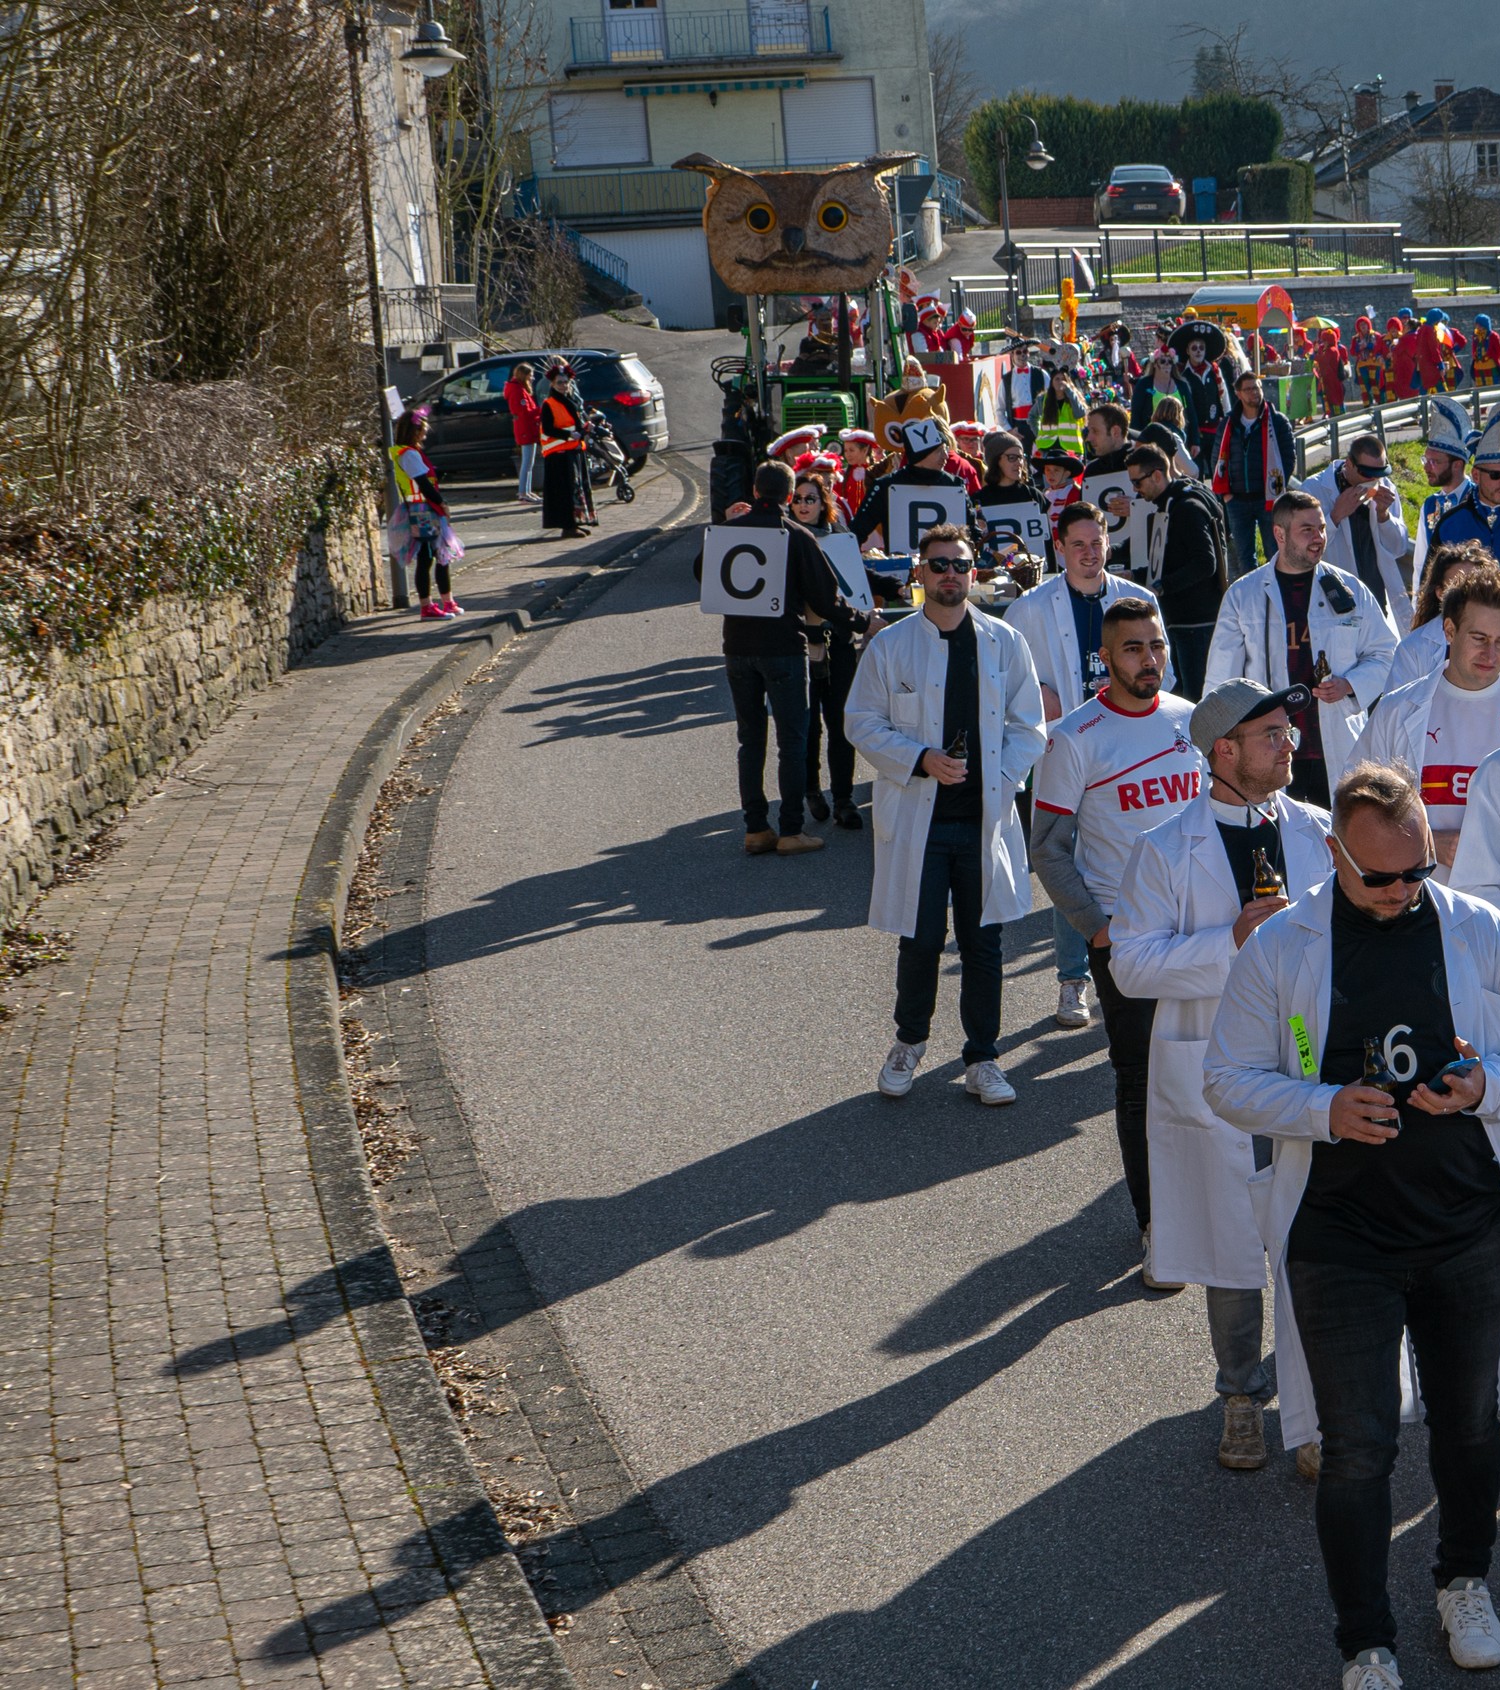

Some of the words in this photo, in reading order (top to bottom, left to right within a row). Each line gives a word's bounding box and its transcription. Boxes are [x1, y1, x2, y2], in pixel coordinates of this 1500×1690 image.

[912, 425, 930, 445] Y
[1026, 519, 1044, 538] B
[720, 543, 768, 600] C
[770, 597, 780, 612] 3
[1076, 713, 1107, 735] uhlsport
[1383, 1023, 1418, 1083] 6
